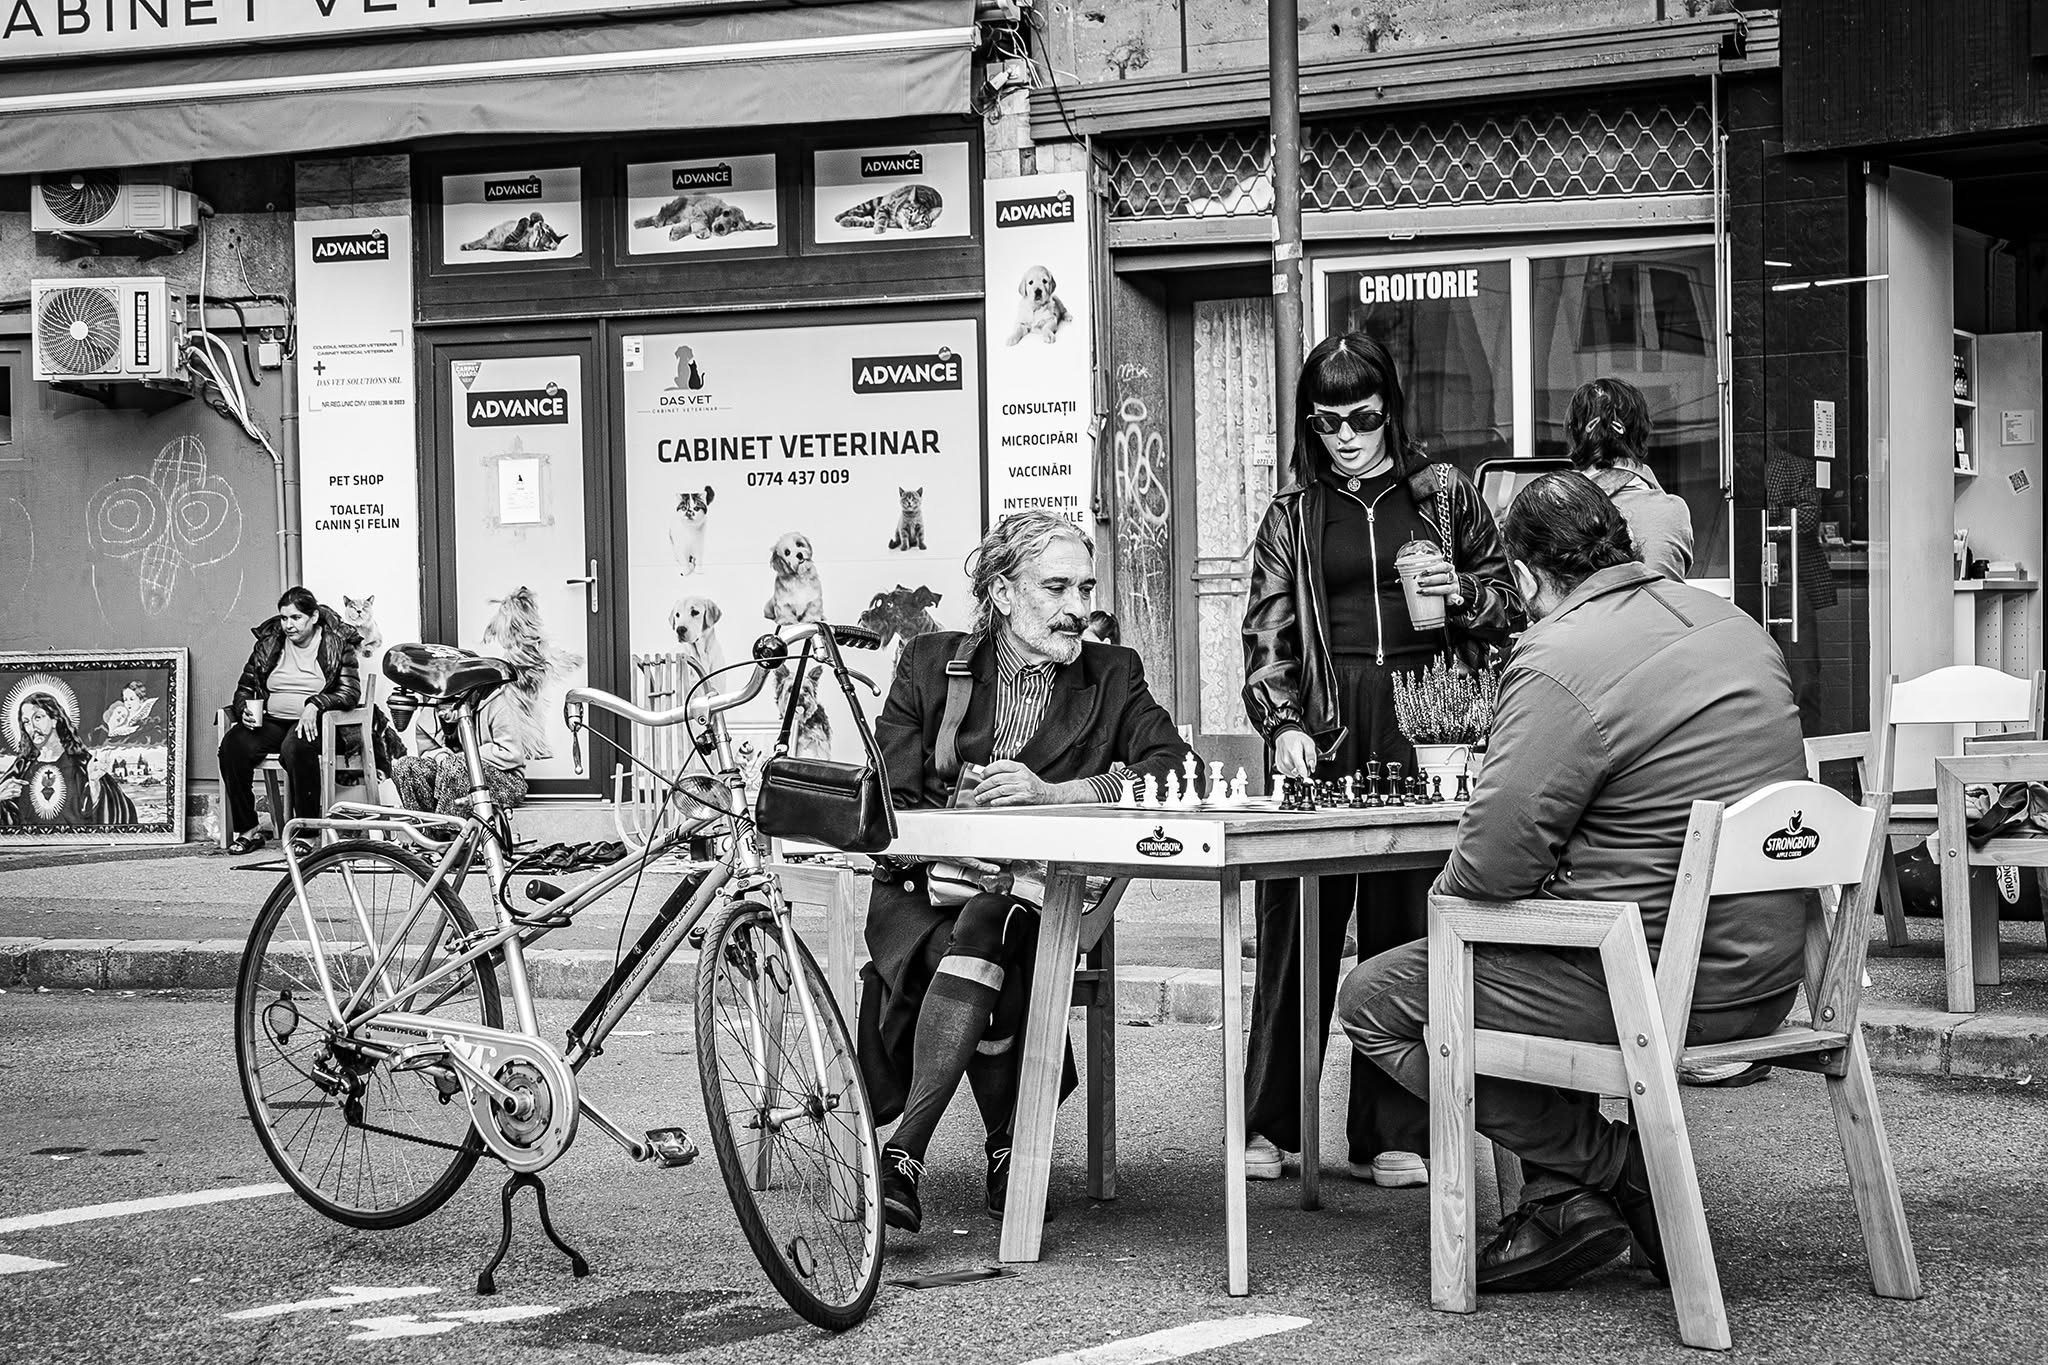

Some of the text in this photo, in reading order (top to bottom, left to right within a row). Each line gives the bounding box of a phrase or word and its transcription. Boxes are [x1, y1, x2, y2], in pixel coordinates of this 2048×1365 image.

[865, 158, 920, 173] ADVANCE
[676, 171, 729, 185] ADVANCE
[488, 184, 539, 196] ADVANCE
[999, 201, 1071, 222] ADVANCE
[316, 240, 385, 257] ADVANCE
[1360, 269, 1478, 304] CROITORIE
[137, 294, 147, 363] HEINNER
[317, 376, 402, 387] DAS VET SOLUTIONS SRL
[857, 363, 957, 385] ADVANCE
[660, 394, 712, 406] DAS VET
[472, 398, 564, 419] ADVANCE
[1002, 401, 1076, 416] CONSULTAȚII
[657, 429, 941, 463] CABINET VETERINAR
[1002, 430, 1078, 447] MICROCIPĂRI
[1008, 462, 1072, 477] VACCINĂRI
[329, 474, 384, 486] PET SHOP
[747, 469, 850, 487] 0774 437 009
[330, 504, 383, 516] TOALETAJ
[1004, 496, 1078, 510] INTERVENȚII
[315, 518, 400, 533] CANIN ȘI FELIN
[1139, 842, 1181, 852] STRONGBOW
[1766, 835, 1817, 852] STRONGBOW
